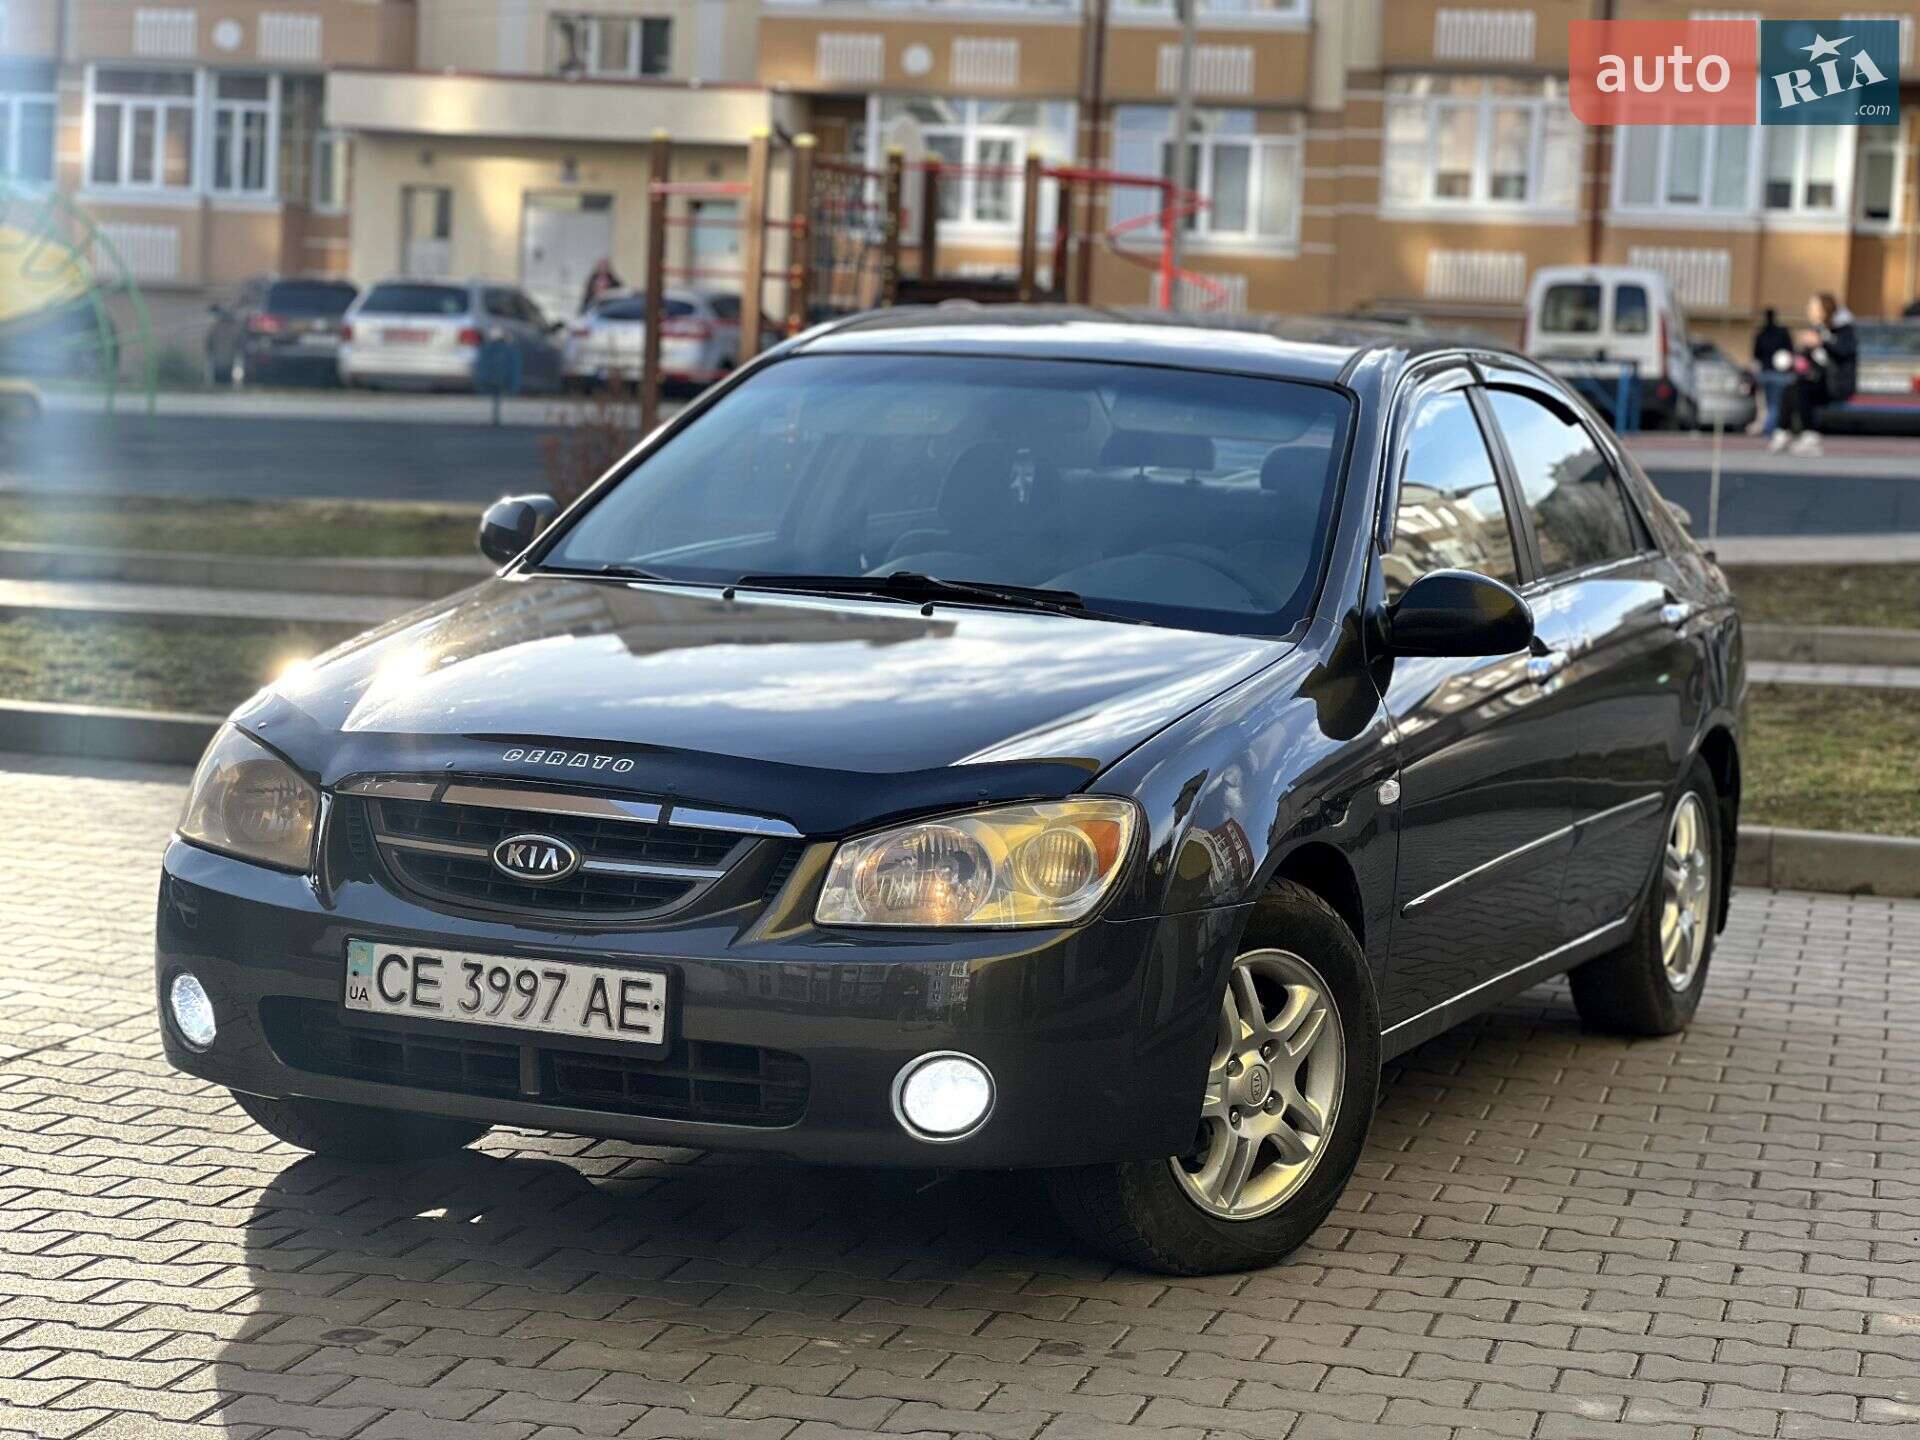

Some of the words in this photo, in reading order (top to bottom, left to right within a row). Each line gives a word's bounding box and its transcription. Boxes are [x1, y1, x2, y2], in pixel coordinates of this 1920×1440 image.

[502, 749, 635, 773] CERATO
[507, 843, 559, 871] KIA
[349, 986, 369, 1001] UA
[377, 953, 443, 1009] CE
[458, 958, 568, 1023] 3997
[581, 974, 653, 1032] AE
